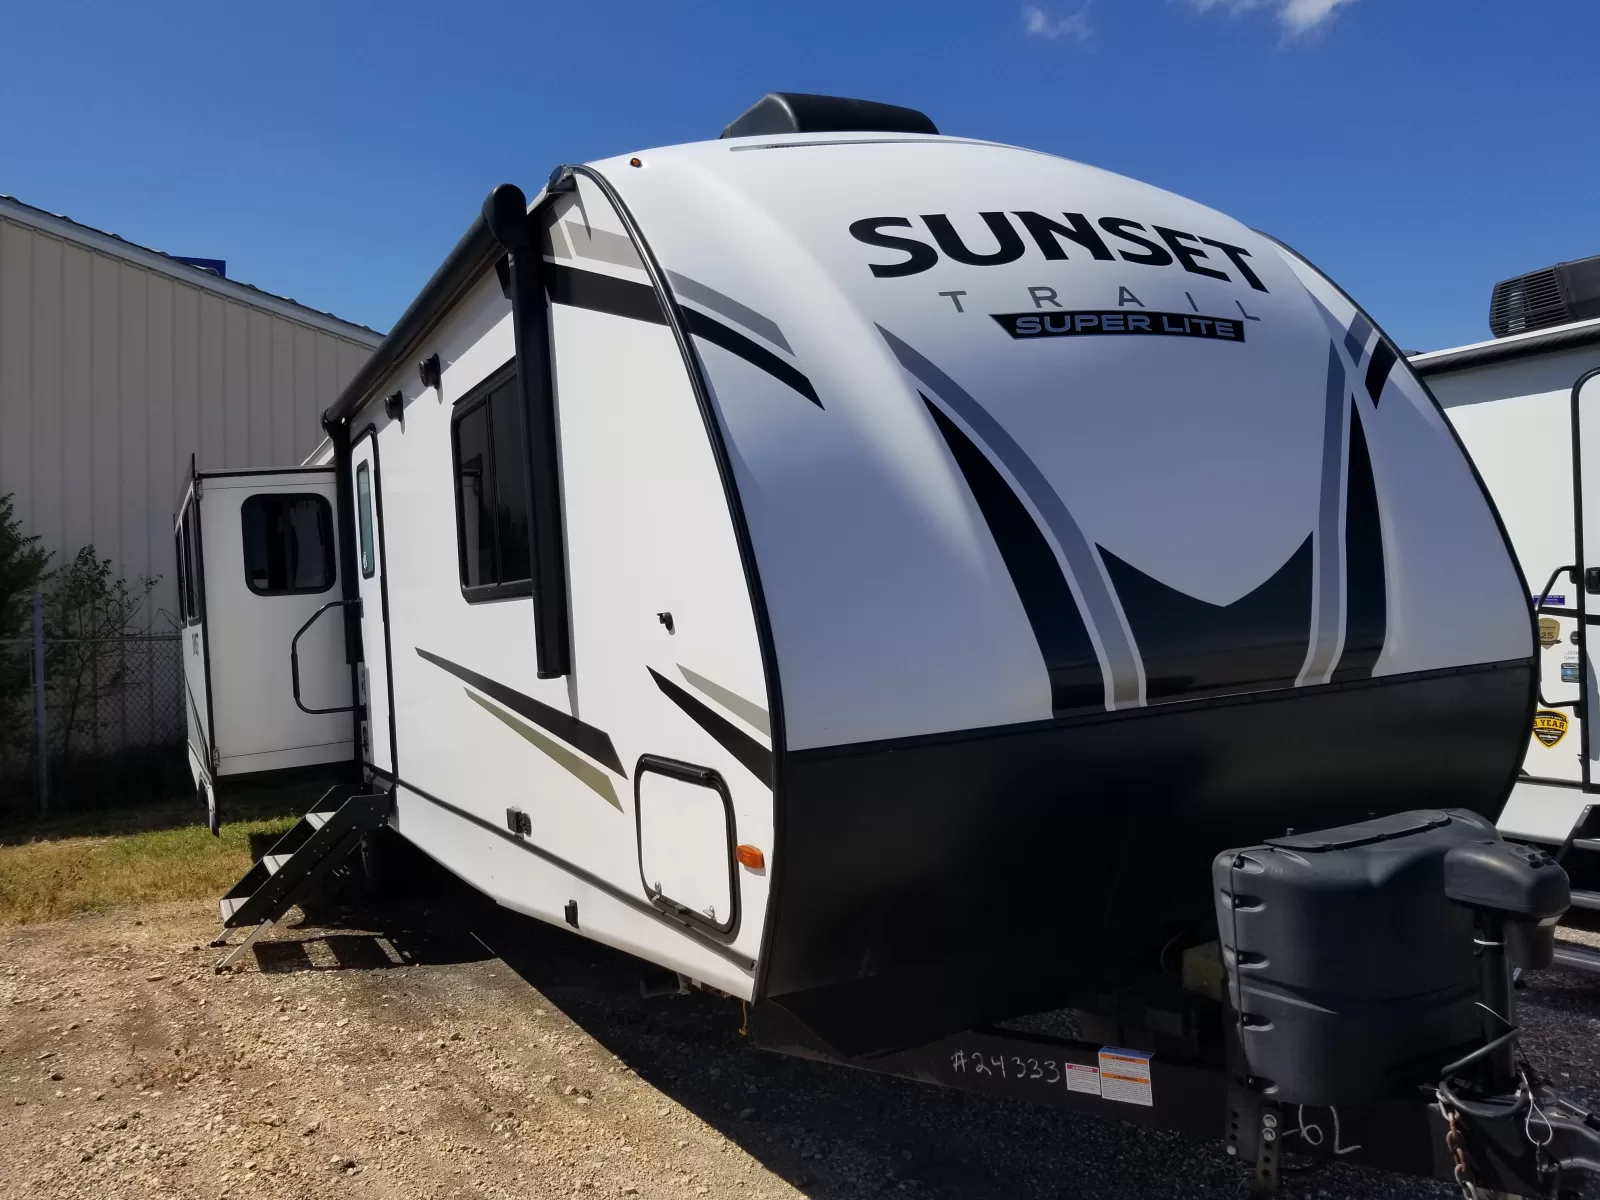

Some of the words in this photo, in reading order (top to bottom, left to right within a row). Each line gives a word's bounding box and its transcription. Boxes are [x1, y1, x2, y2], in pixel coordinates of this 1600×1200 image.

[848, 210, 1271, 295] SUNSET
[938, 285, 1262, 322] TRAIL
[1015, 314, 1153, 334] SUPER
[1162, 315, 1236, 338] LITE
[1540, 719, 1565, 729] YEAR
